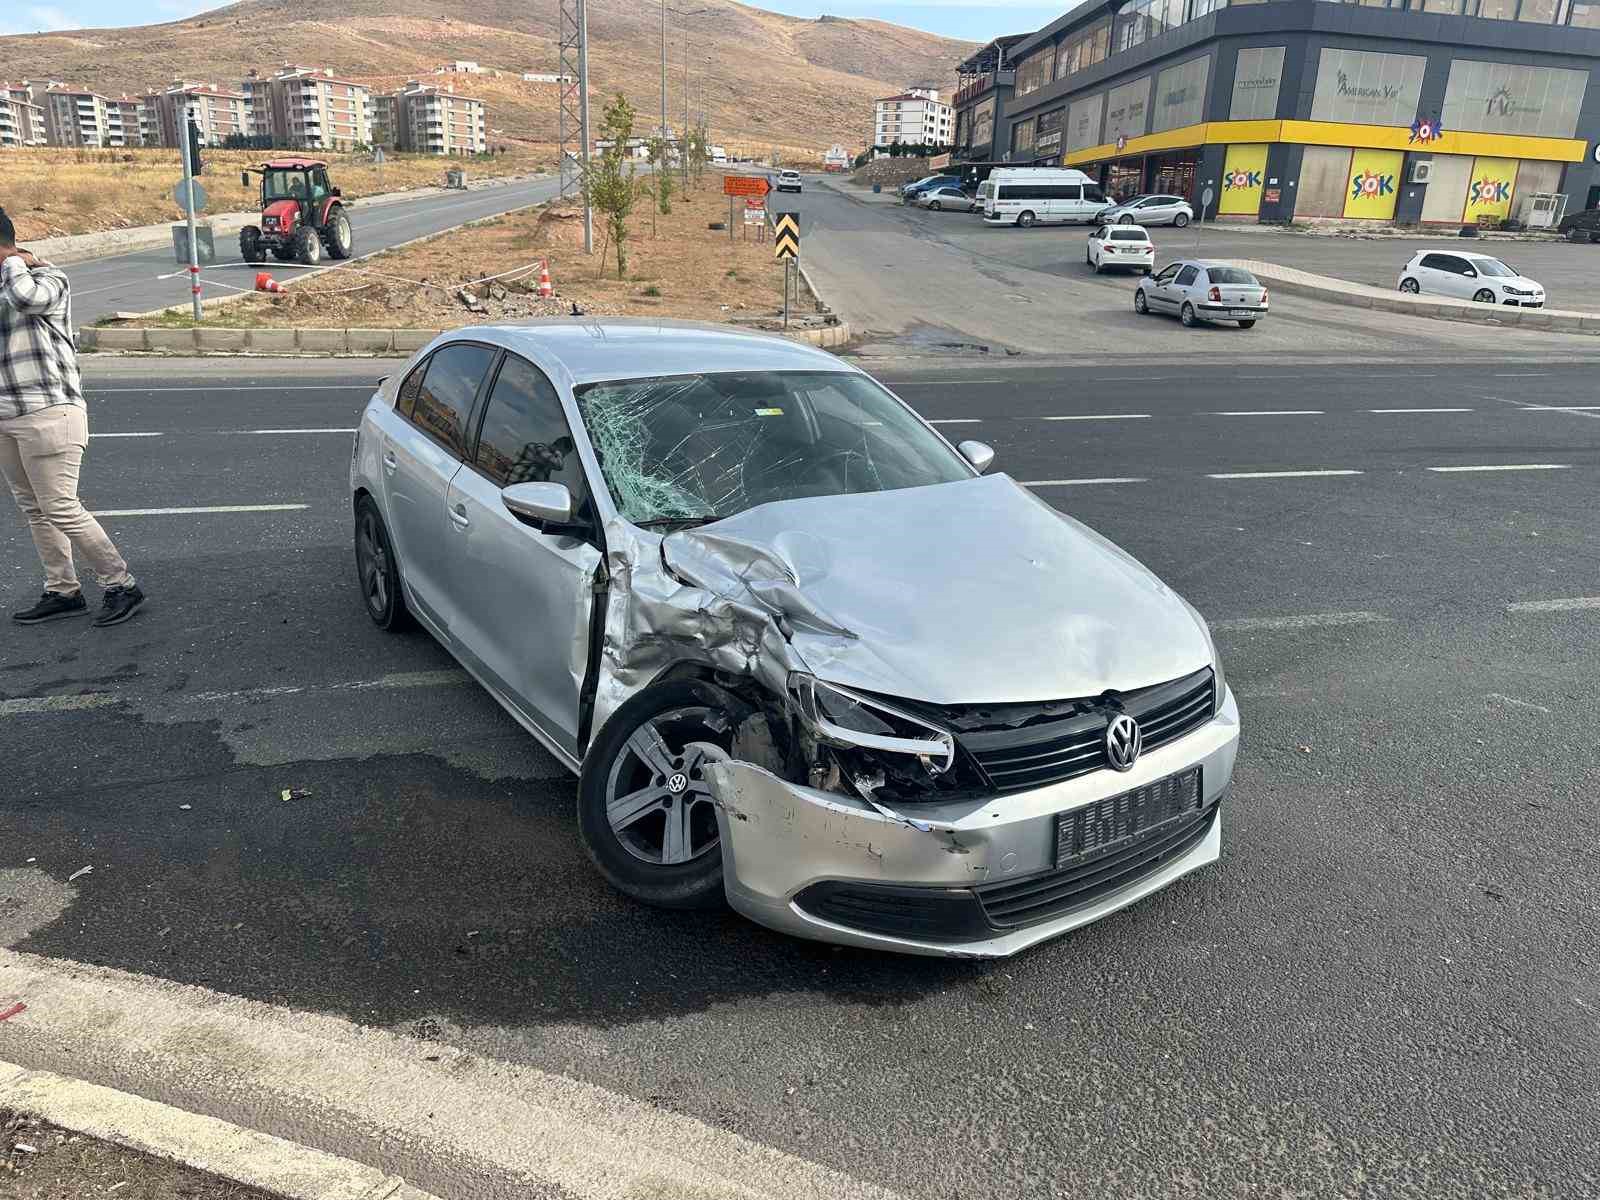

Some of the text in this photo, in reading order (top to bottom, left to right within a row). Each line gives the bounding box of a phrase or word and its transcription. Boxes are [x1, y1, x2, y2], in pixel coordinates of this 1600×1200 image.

[1225, 170, 1261, 191] ŞOK
[1352, 173, 1394, 200] ŞOK
[1471, 180, 1509, 205] ŞOK
